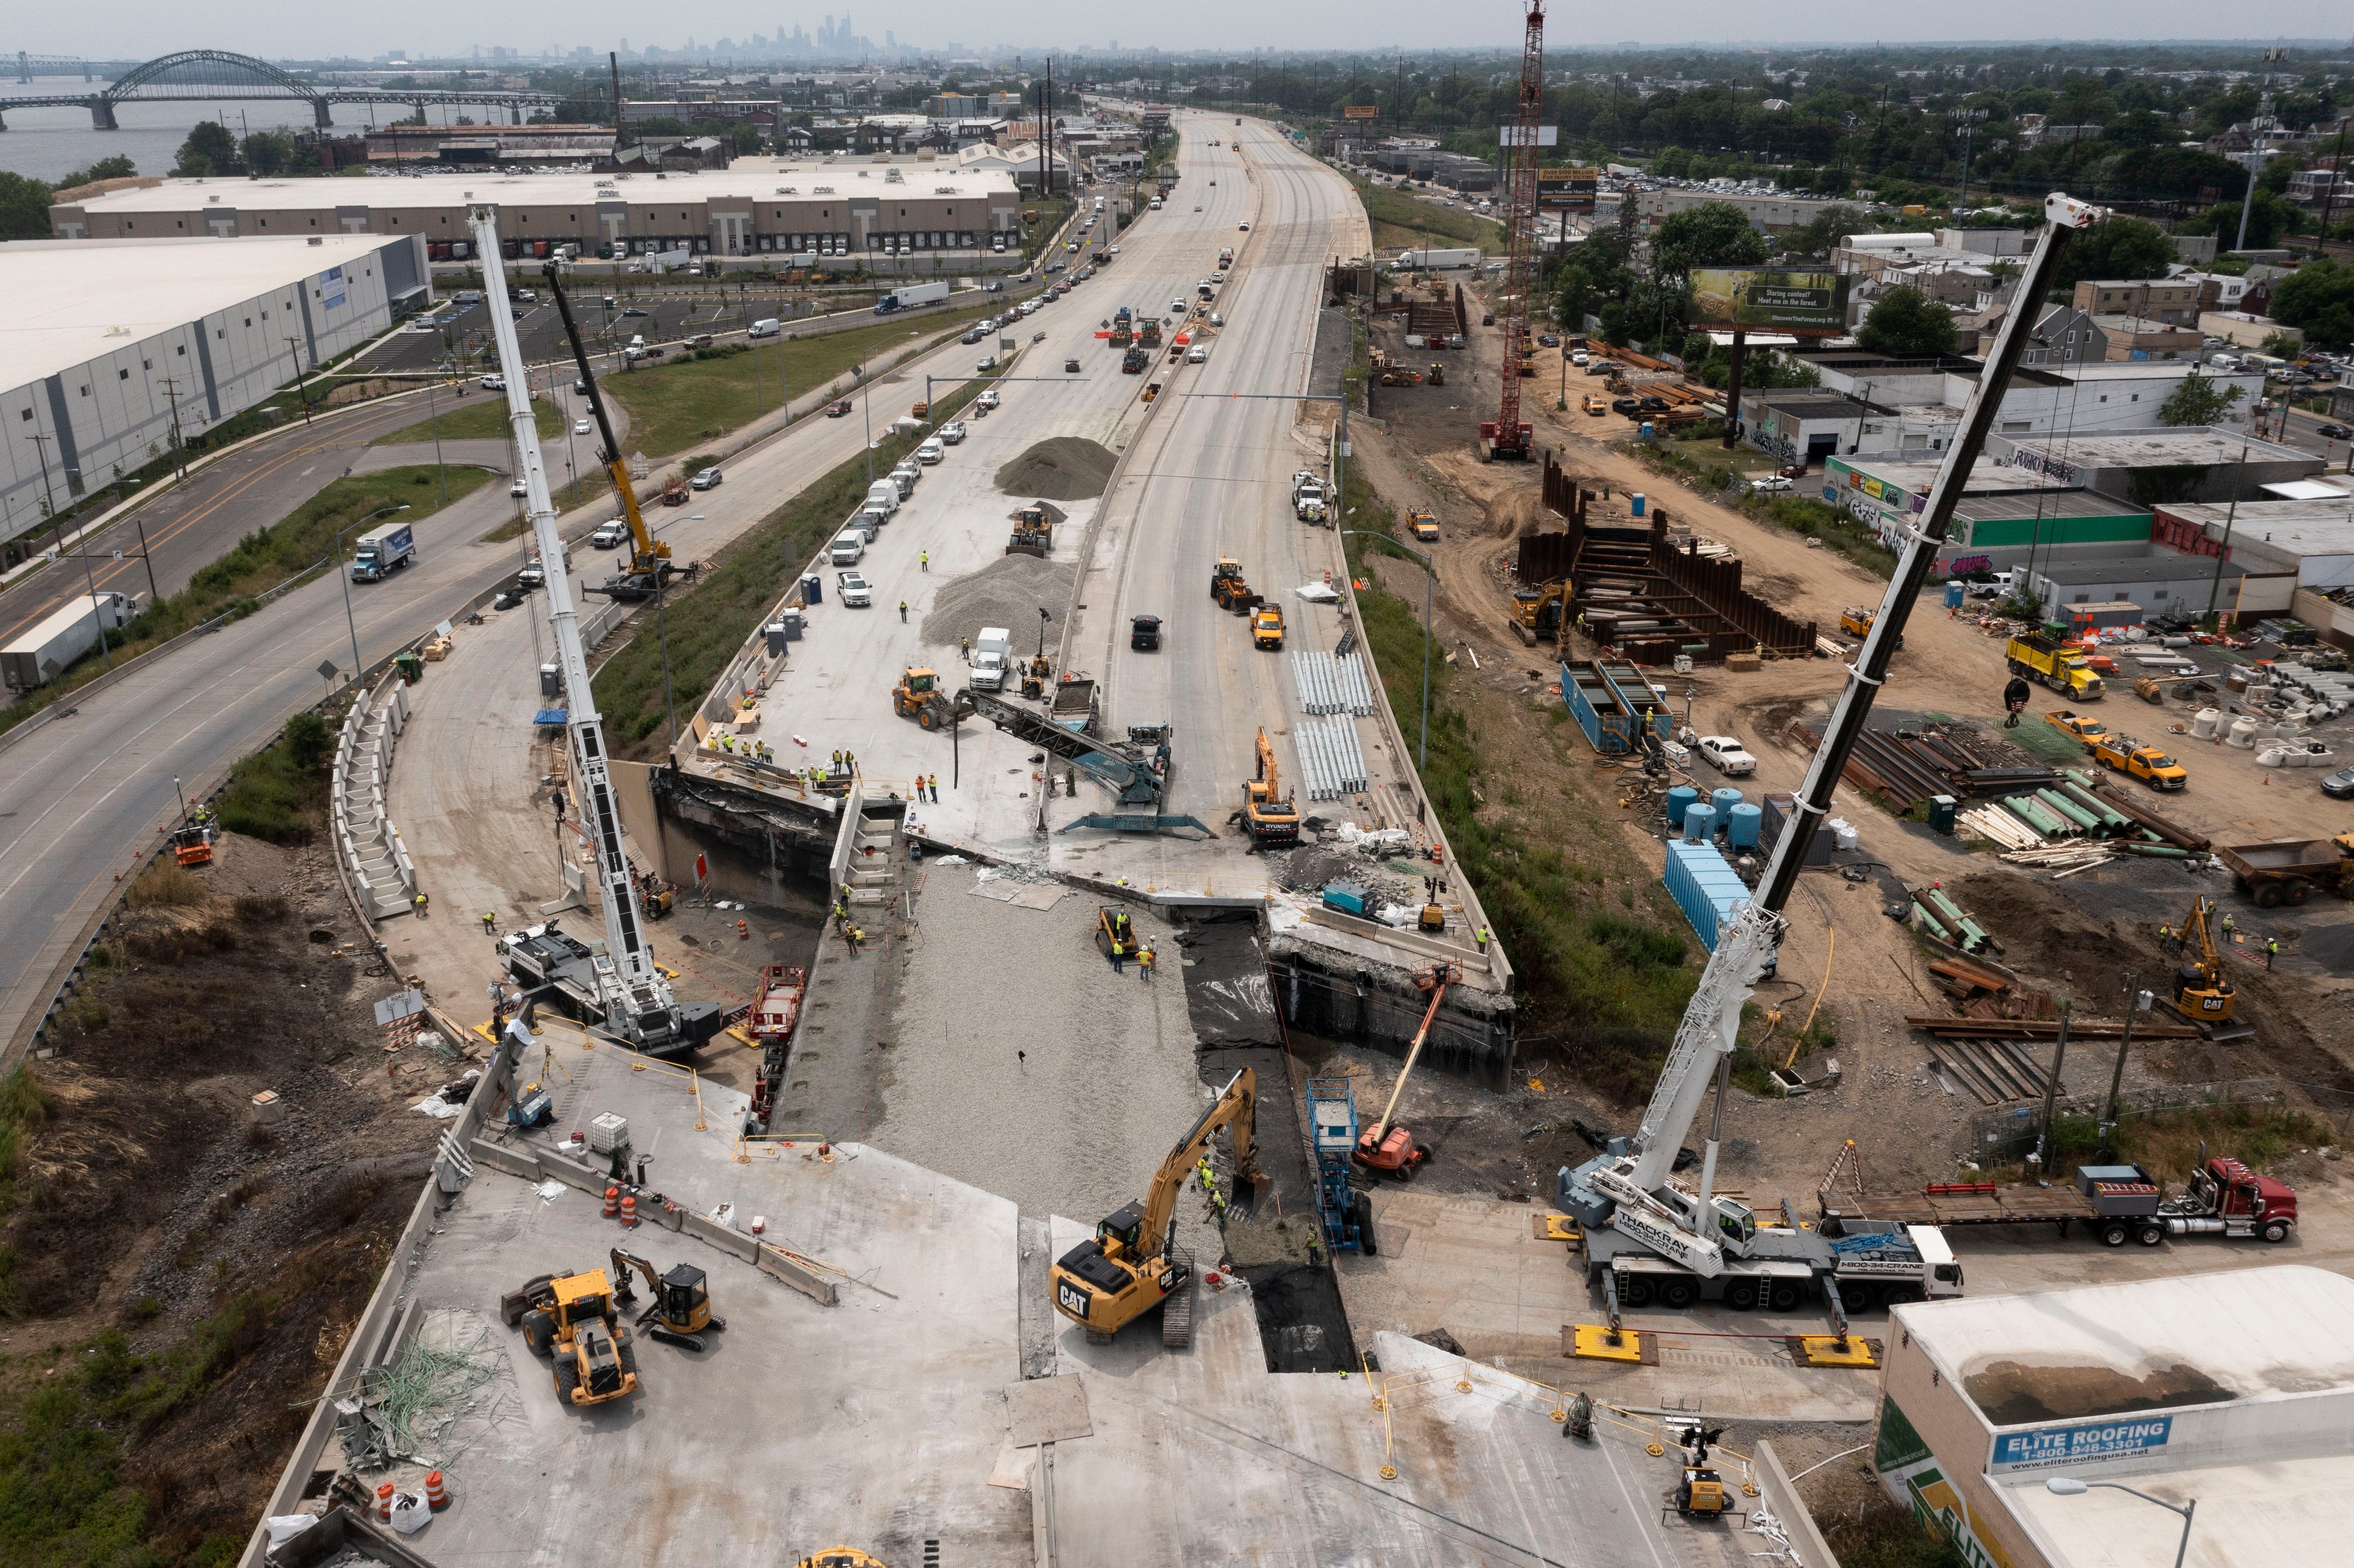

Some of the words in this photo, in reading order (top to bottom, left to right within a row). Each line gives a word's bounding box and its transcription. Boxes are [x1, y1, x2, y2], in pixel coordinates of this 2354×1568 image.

[1766, 289, 1786, 298] Staring
[1772, 315, 1825, 323] DiscoverTheForest.org
[391, 994, 405, 1002] ROAD
[2204, 999, 2223, 1009] CAT
[1620, 1211, 1689, 1252] THACKRAY
[1620, 1220, 1688, 1259] 1-800-34-CRANE
[1161, 1270, 1172, 1286] CAT
[1060, 1285, 1086, 1316] CAT
[699, 1308, 707, 1317] CAT
[2007, 1433, 2066, 1451] ELITE
[2072, 1423, 2164, 1444] ROOFING
[2011, 1448, 2149, 1470] www.eliteroofingusa.net
[2021, 1439, 2143, 1460] 1-800-948-3301
[1942, 1505, 1993, 1568] ELIT
